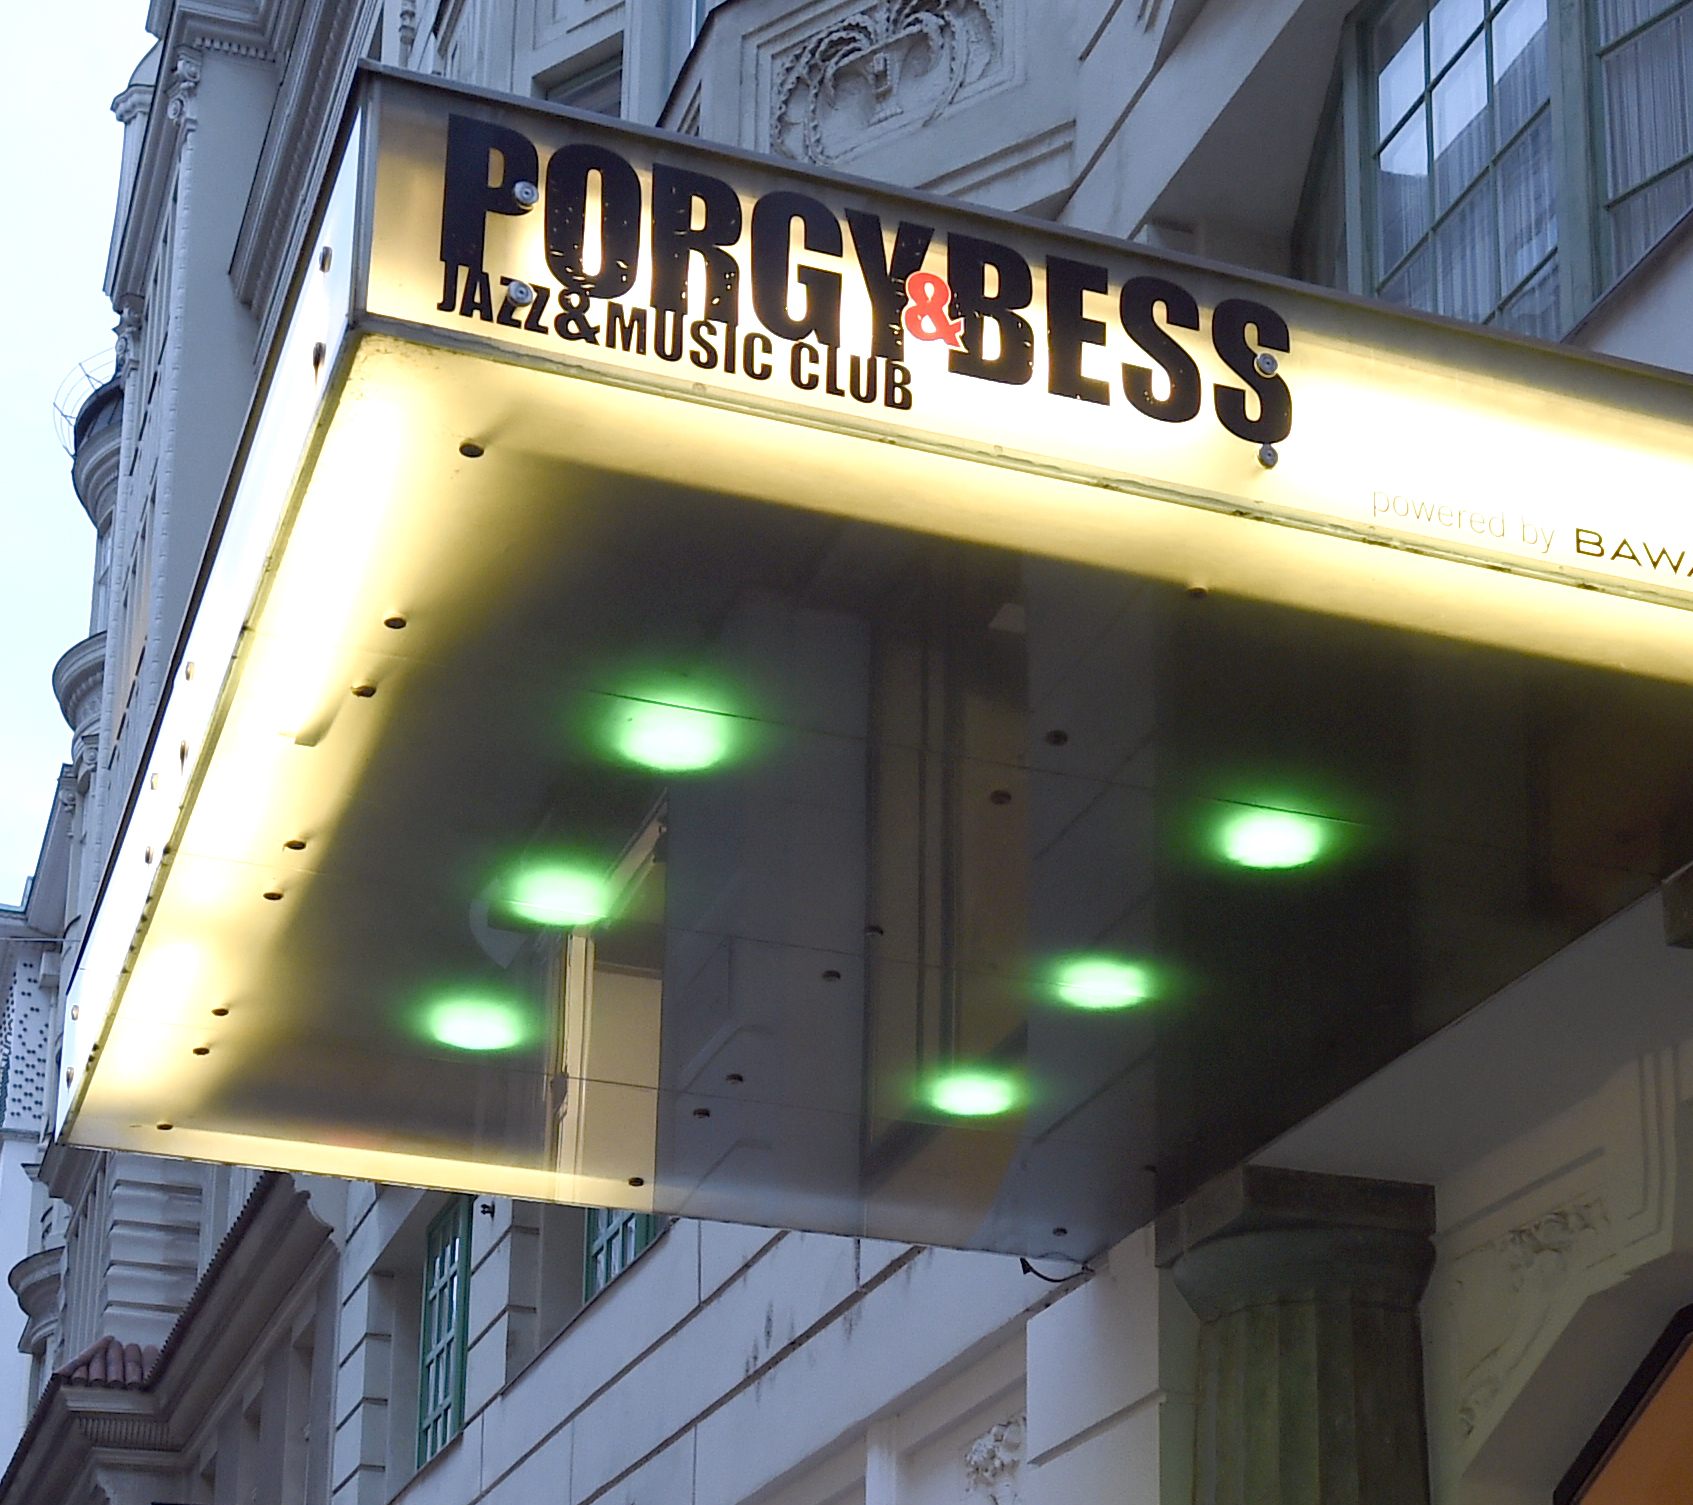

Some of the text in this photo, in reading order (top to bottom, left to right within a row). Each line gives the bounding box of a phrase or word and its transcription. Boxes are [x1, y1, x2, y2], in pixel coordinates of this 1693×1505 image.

[789, 342, 912, 410] CLUB
[1372, 490, 1693, 578] powered by BAW
